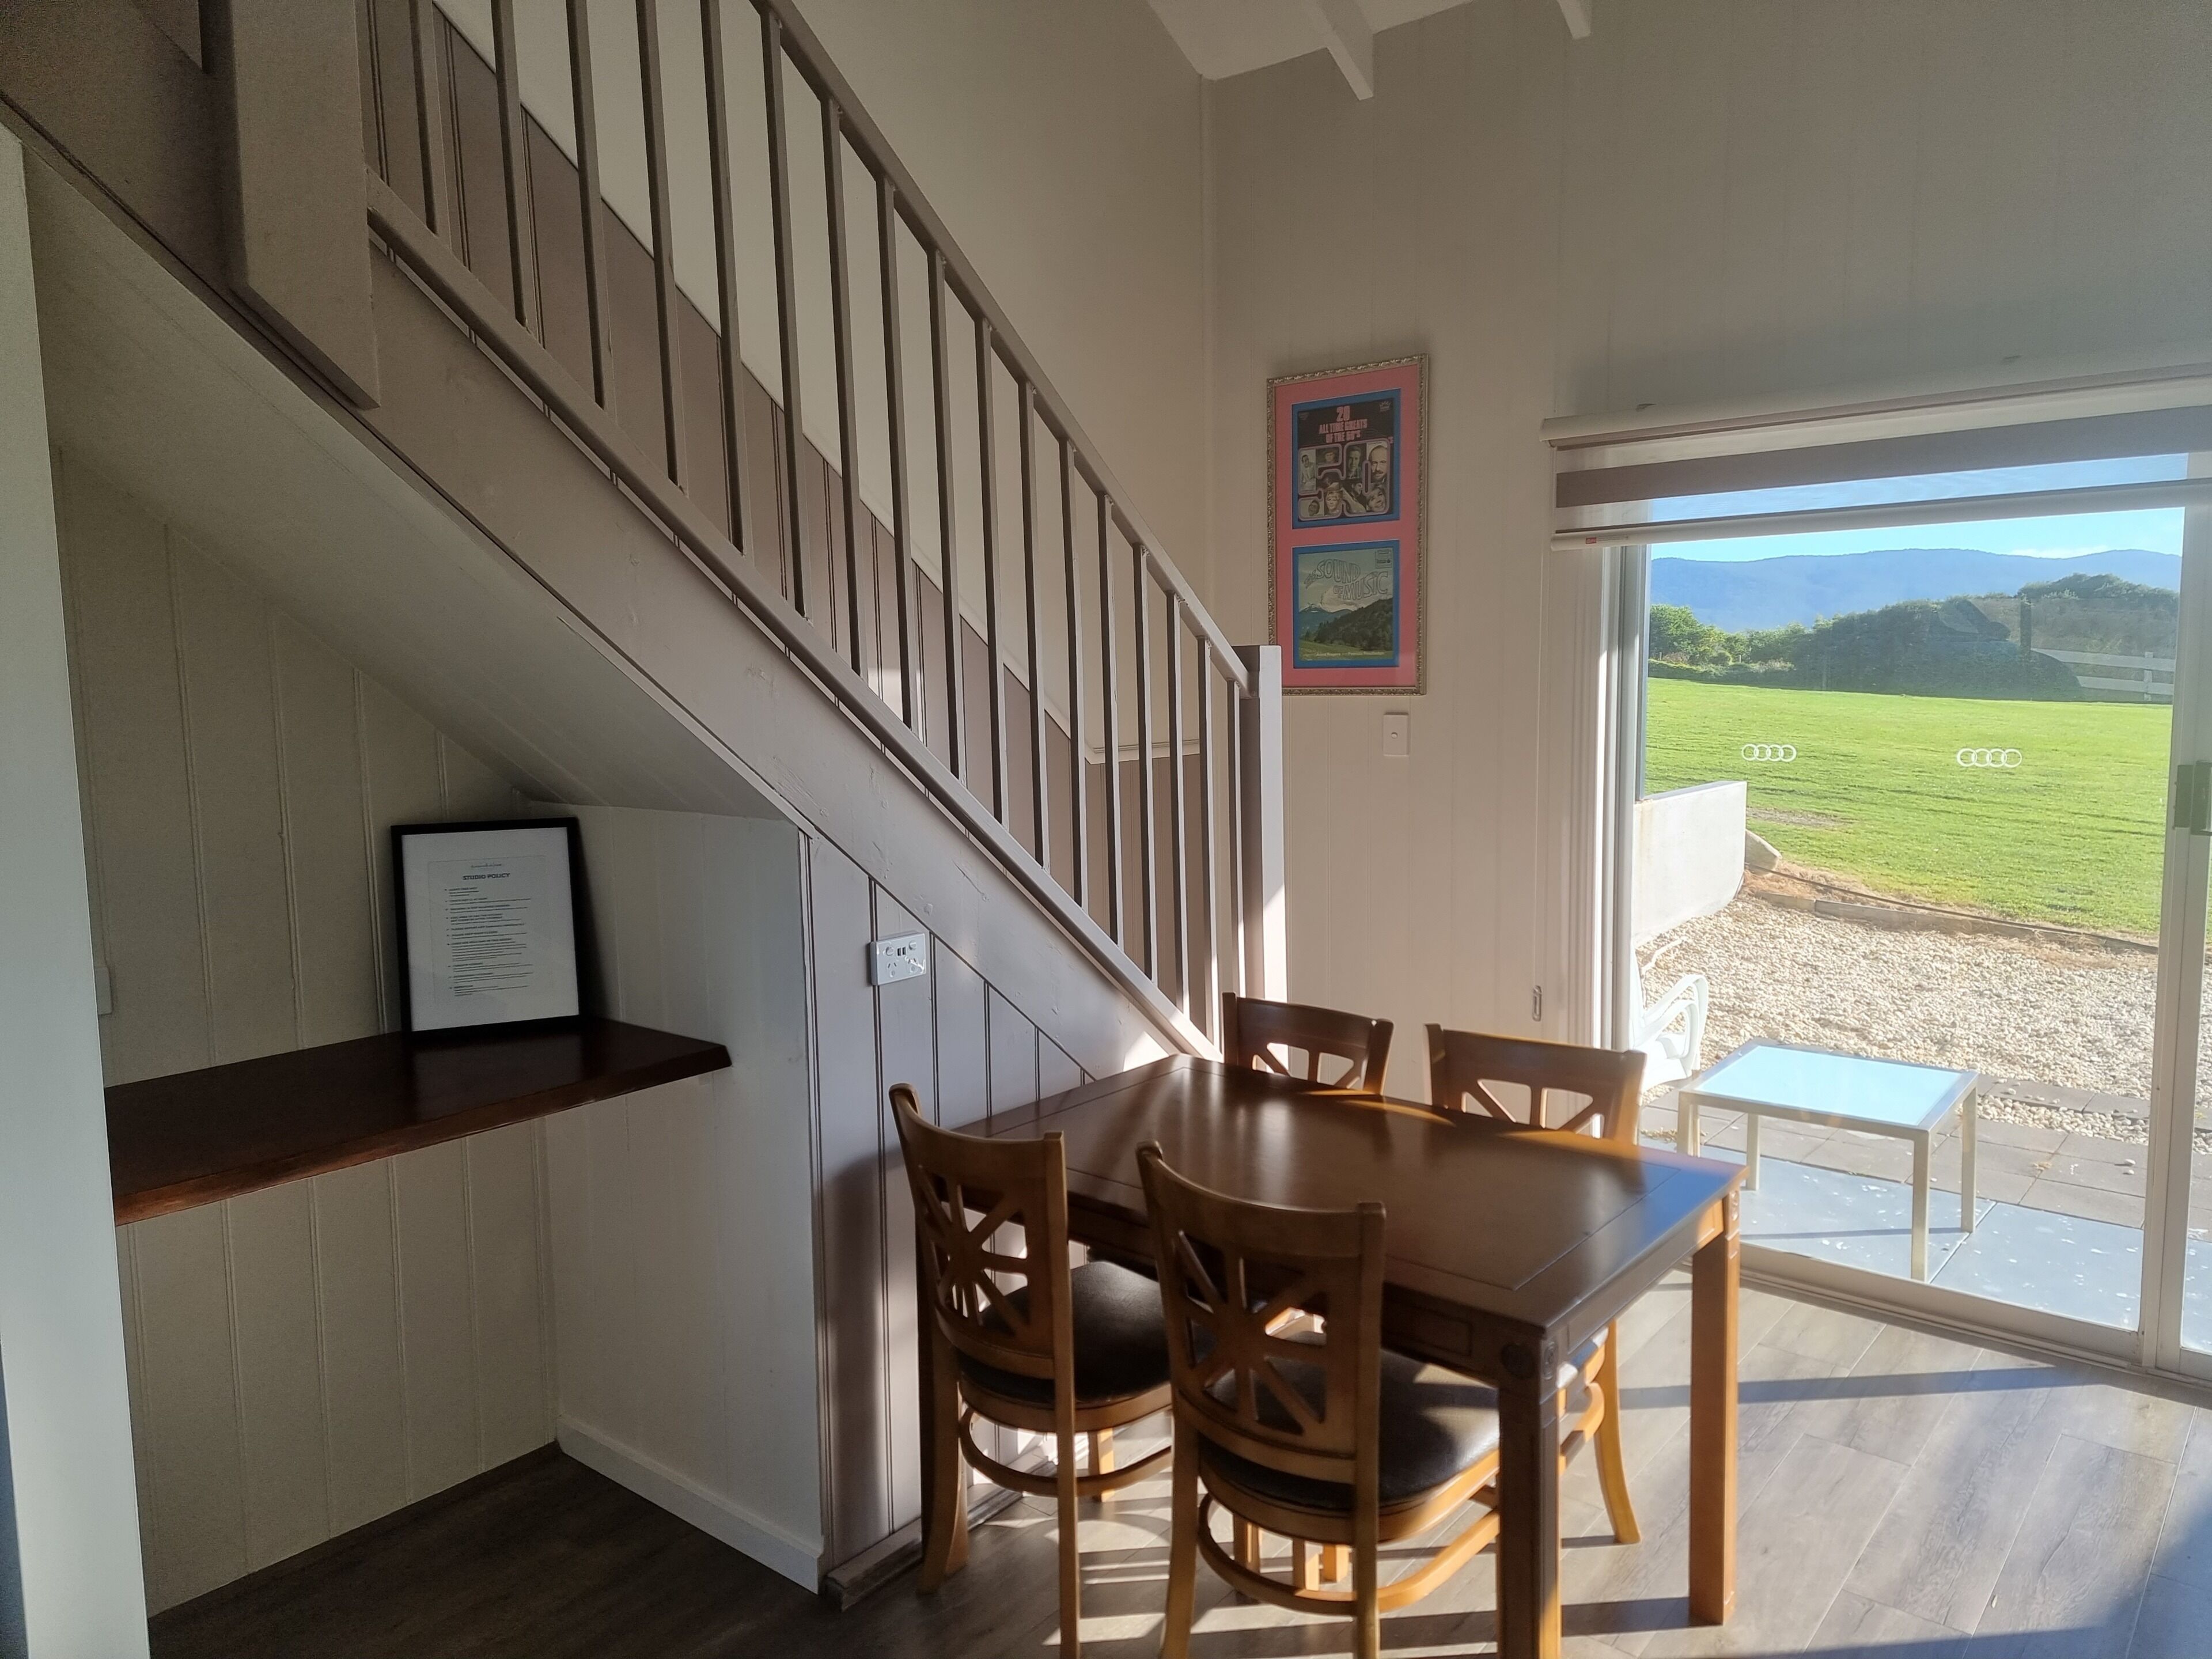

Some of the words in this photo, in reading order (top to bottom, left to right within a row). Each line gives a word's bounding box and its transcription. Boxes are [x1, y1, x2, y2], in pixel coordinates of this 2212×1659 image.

[1336, 405, 1350, 422] 20
[1319, 423, 1329, 434] ALL
[1329, 422, 1344, 433] TIME
[1344, 419, 1368, 431] GREATS
[1325, 433, 1333, 444] OF
[1334, 431, 1345, 442] THE
[1304, 570, 1317, 589] THE
[1316, 559, 1361, 584] SOUND
[1333, 585, 1344, 599] OF
[1343, 571, 1388, 600] MUSIC
